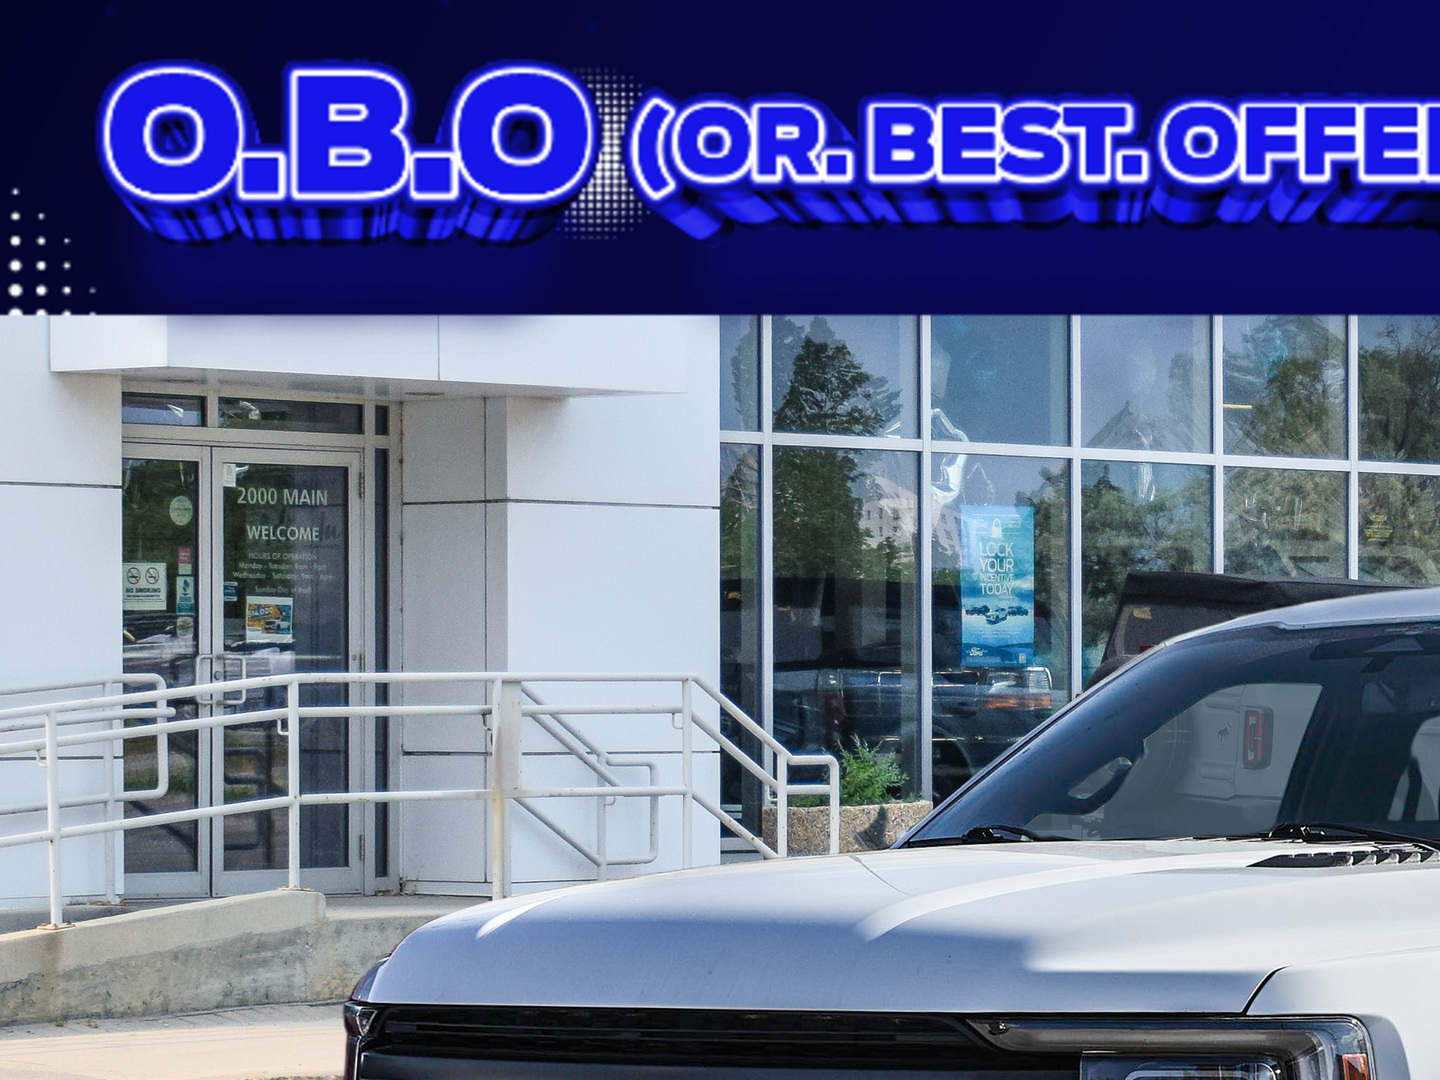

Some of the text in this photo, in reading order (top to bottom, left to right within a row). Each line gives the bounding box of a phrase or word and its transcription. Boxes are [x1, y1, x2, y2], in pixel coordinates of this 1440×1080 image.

[237, 487, 328, 506] 2000 MAIN
[246, 525, 320, 541] WELCOME
[282, 552, 318, 561] OPERATION
[979, 541, 1014, 557] LOCK
[979, 558, 1015, 573] YOUR
[979, 573, 1015, 583] INCENTIVE
[979, 583, 1014, 596] TODAY
